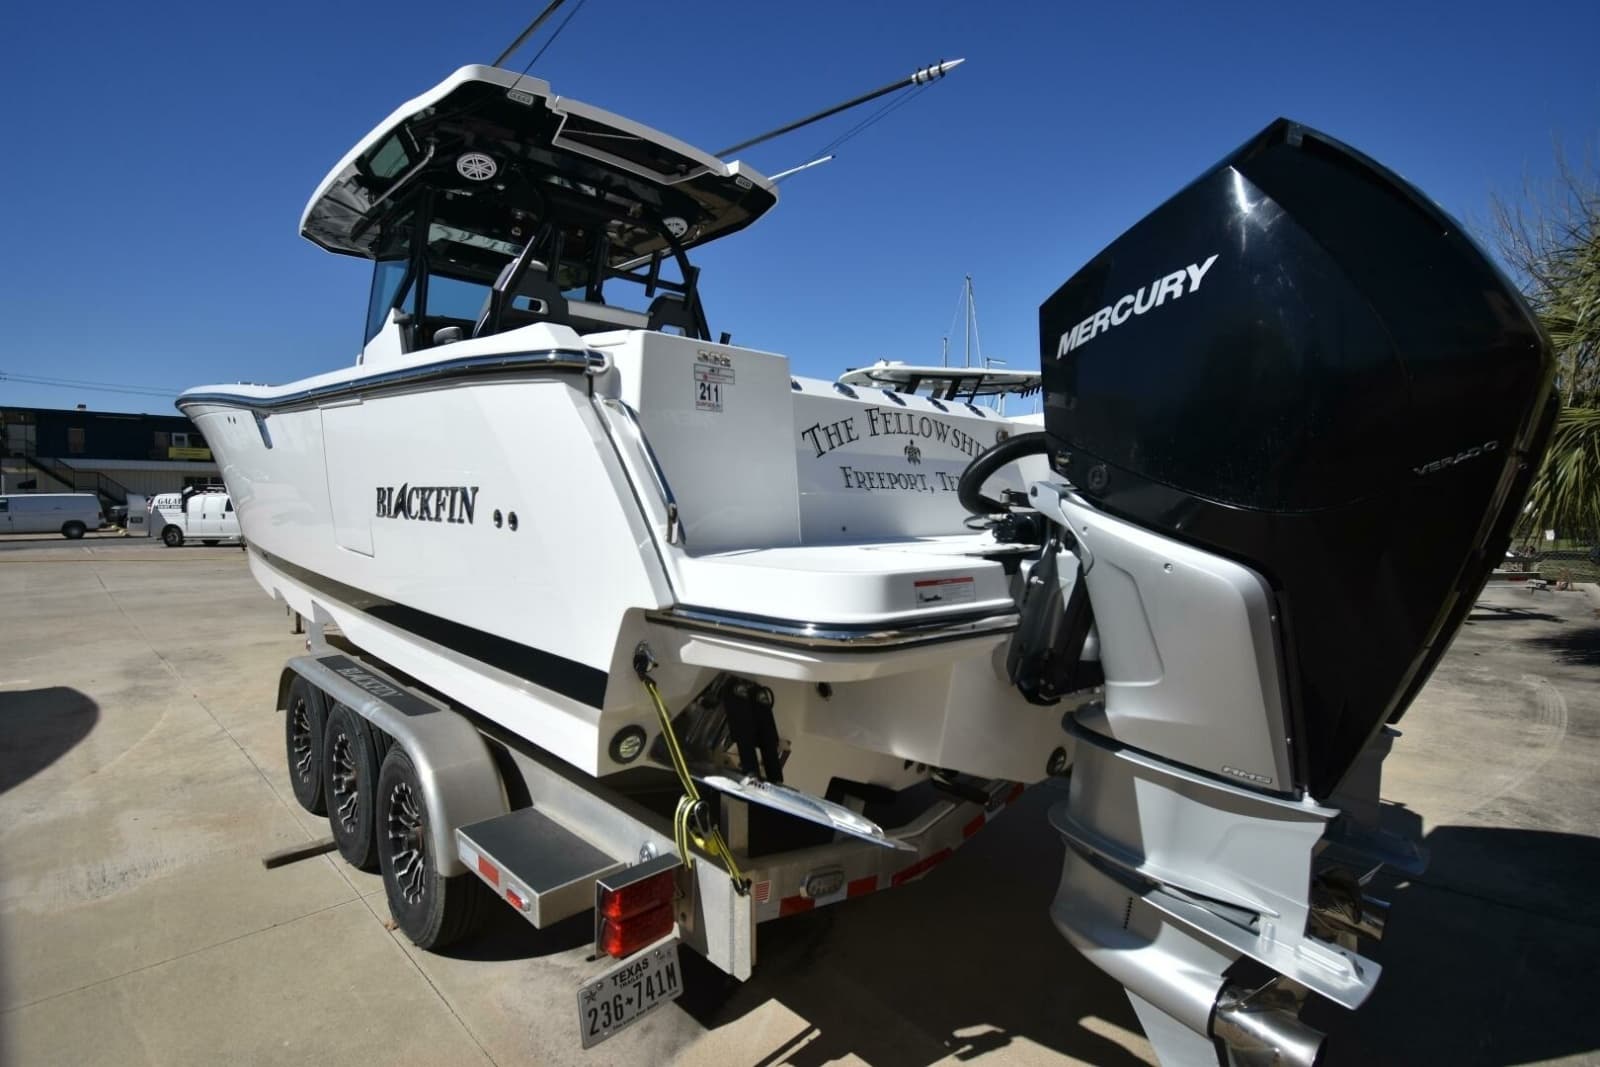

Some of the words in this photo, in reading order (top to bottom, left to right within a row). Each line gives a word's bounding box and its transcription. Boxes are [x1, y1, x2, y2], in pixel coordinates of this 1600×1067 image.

[1056, 254, 1219, 360] MERCURY
[699, 382, 719, 403] 211
[802, 416, 859, 459] THE
[376, 482, 479, 525] BLACKFIN
[611, 958, 649, 986] TEXAS
